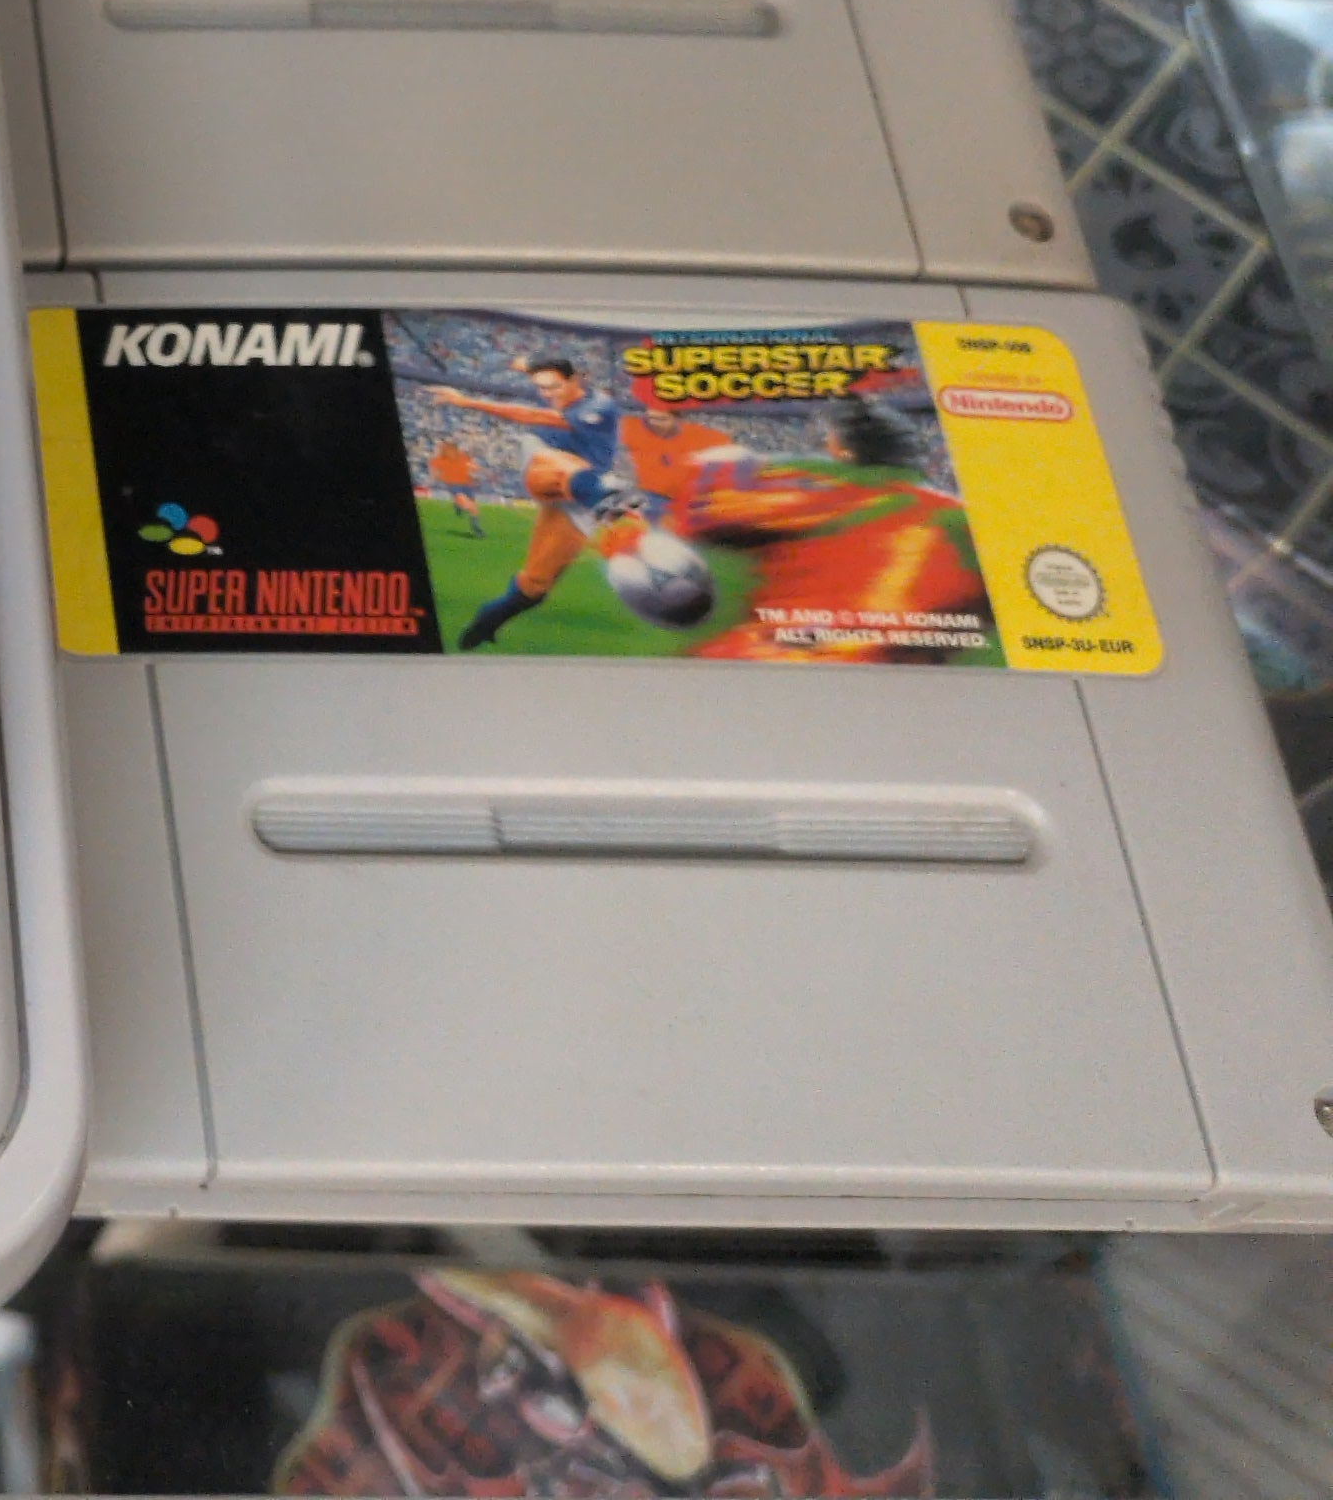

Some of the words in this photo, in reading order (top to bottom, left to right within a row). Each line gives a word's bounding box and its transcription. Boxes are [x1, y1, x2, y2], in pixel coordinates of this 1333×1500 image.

[622, 344, 890, 376] SUPERSTAR
[652, 370, 851, 401] SOCCER
[949, 392, 1065, 416] Nintendo
[143, 569, 247, 615] SUPER
[255, 569, 410, 617] NINTENDO
[790, 608, 833, 624] AND
[902, 611, 982, 629] KONAMI
[774, 627, 816, 644] ALL
[816, 627, 885, 645] RIGHTS
